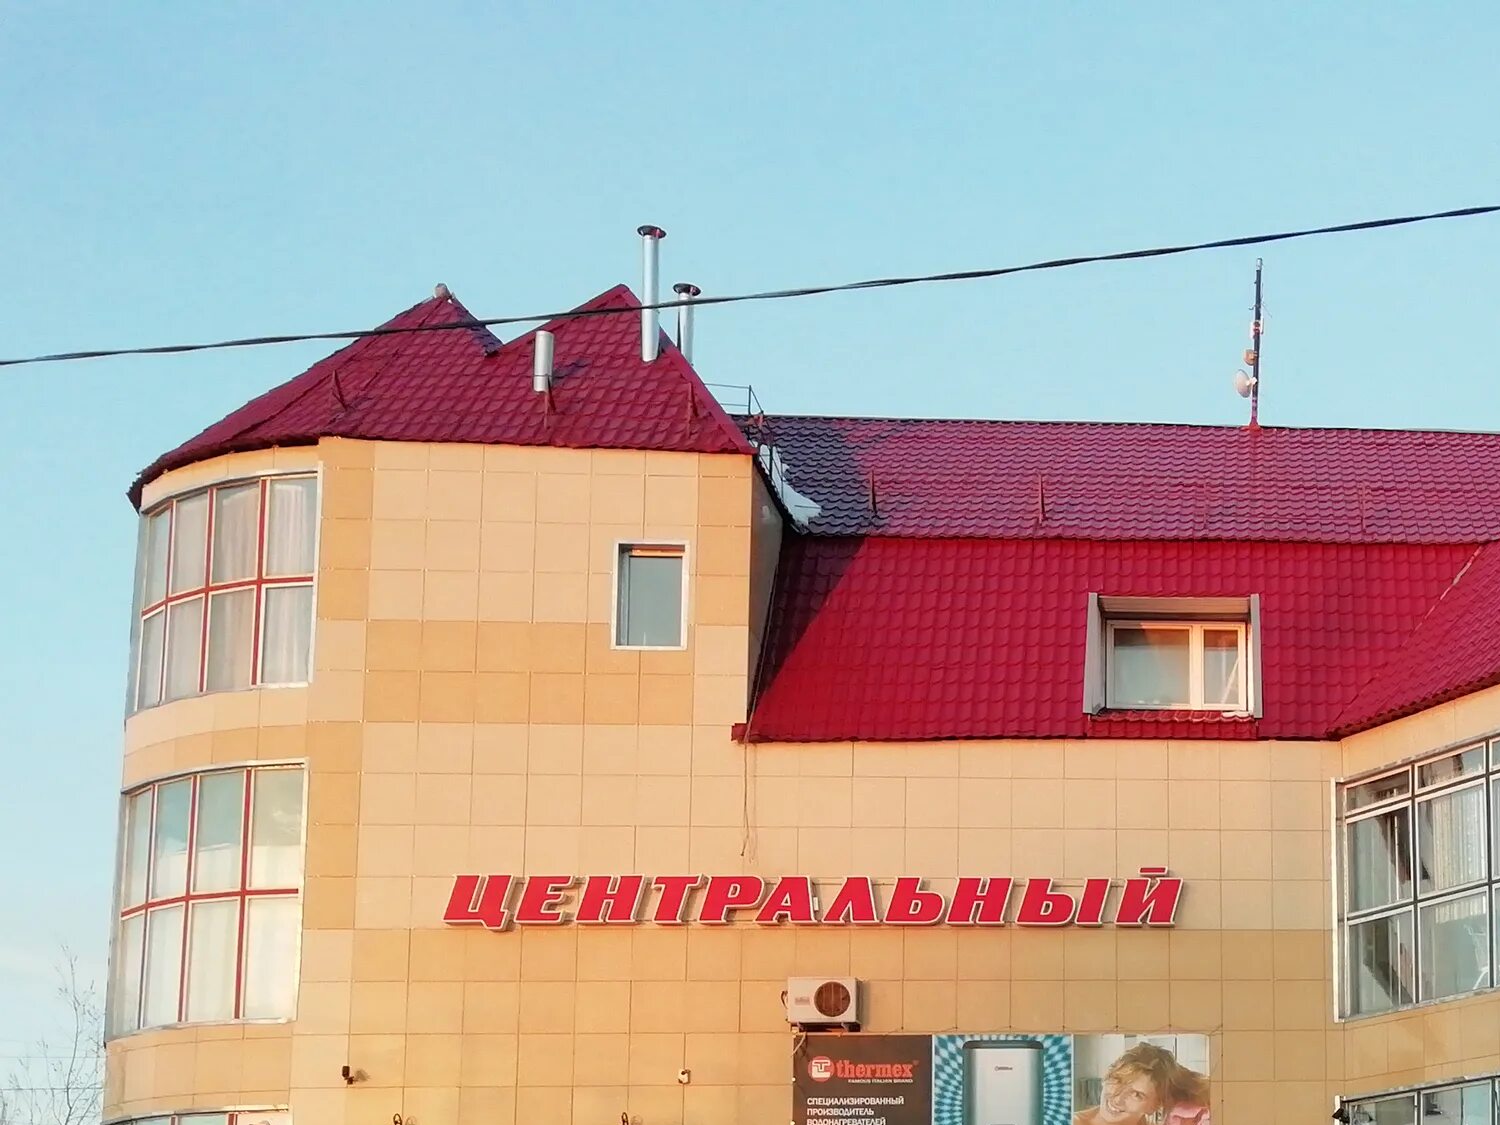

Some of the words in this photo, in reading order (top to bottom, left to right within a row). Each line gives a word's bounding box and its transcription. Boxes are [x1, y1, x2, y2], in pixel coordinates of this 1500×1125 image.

[442, 866, 1184, 932] ЦЕНТРАЛЬНЫЙ
[836, 1059, 913, 1078] thermex
[806, 1096, 905, 1106] СПЕЦИАЛИЗИРОВАННЫЙ
[806, 1108, 875, 1116] ПРОИЗВОДИТЕЛЬ
